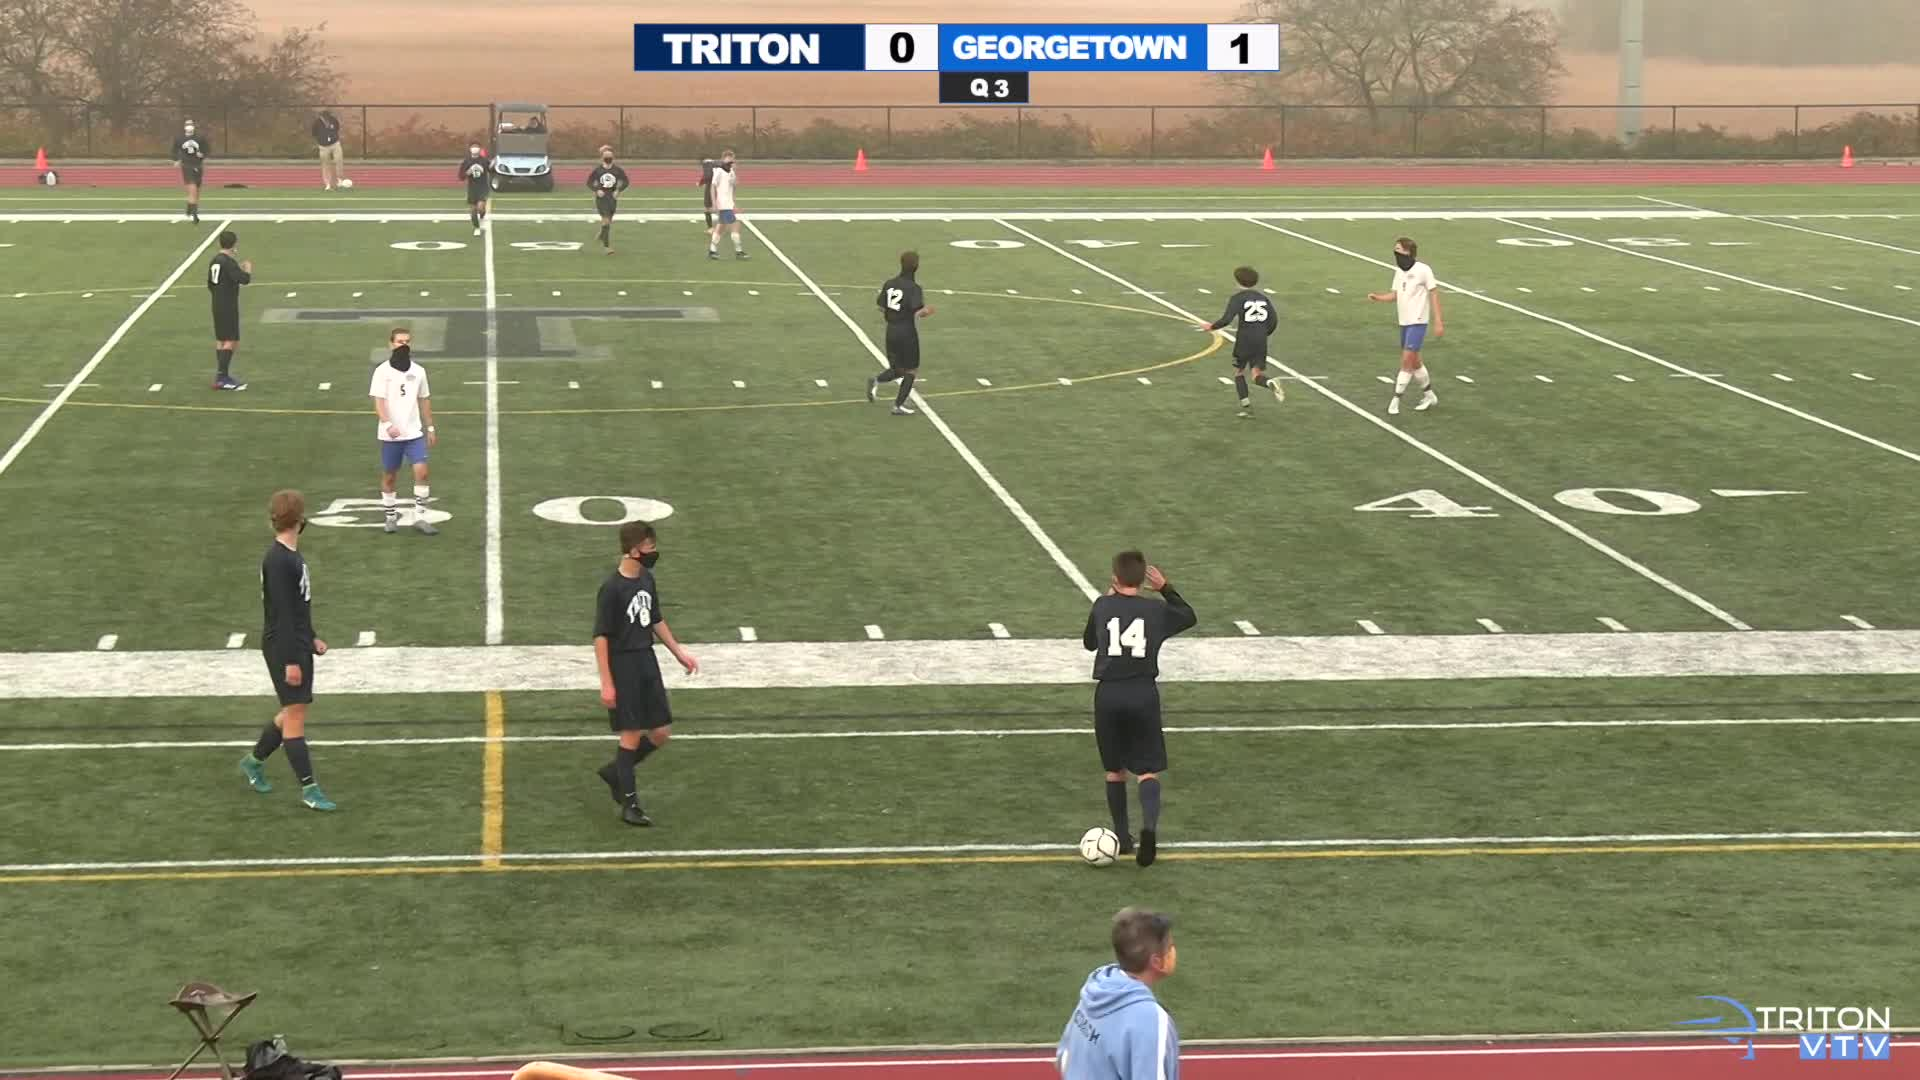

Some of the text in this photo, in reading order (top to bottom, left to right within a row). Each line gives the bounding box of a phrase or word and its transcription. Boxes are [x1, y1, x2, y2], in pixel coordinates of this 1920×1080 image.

[886, 288, 904, 311] 12
[1243, 301, 1269, 322] 25
[1106, 616, 1147, 659] 14
